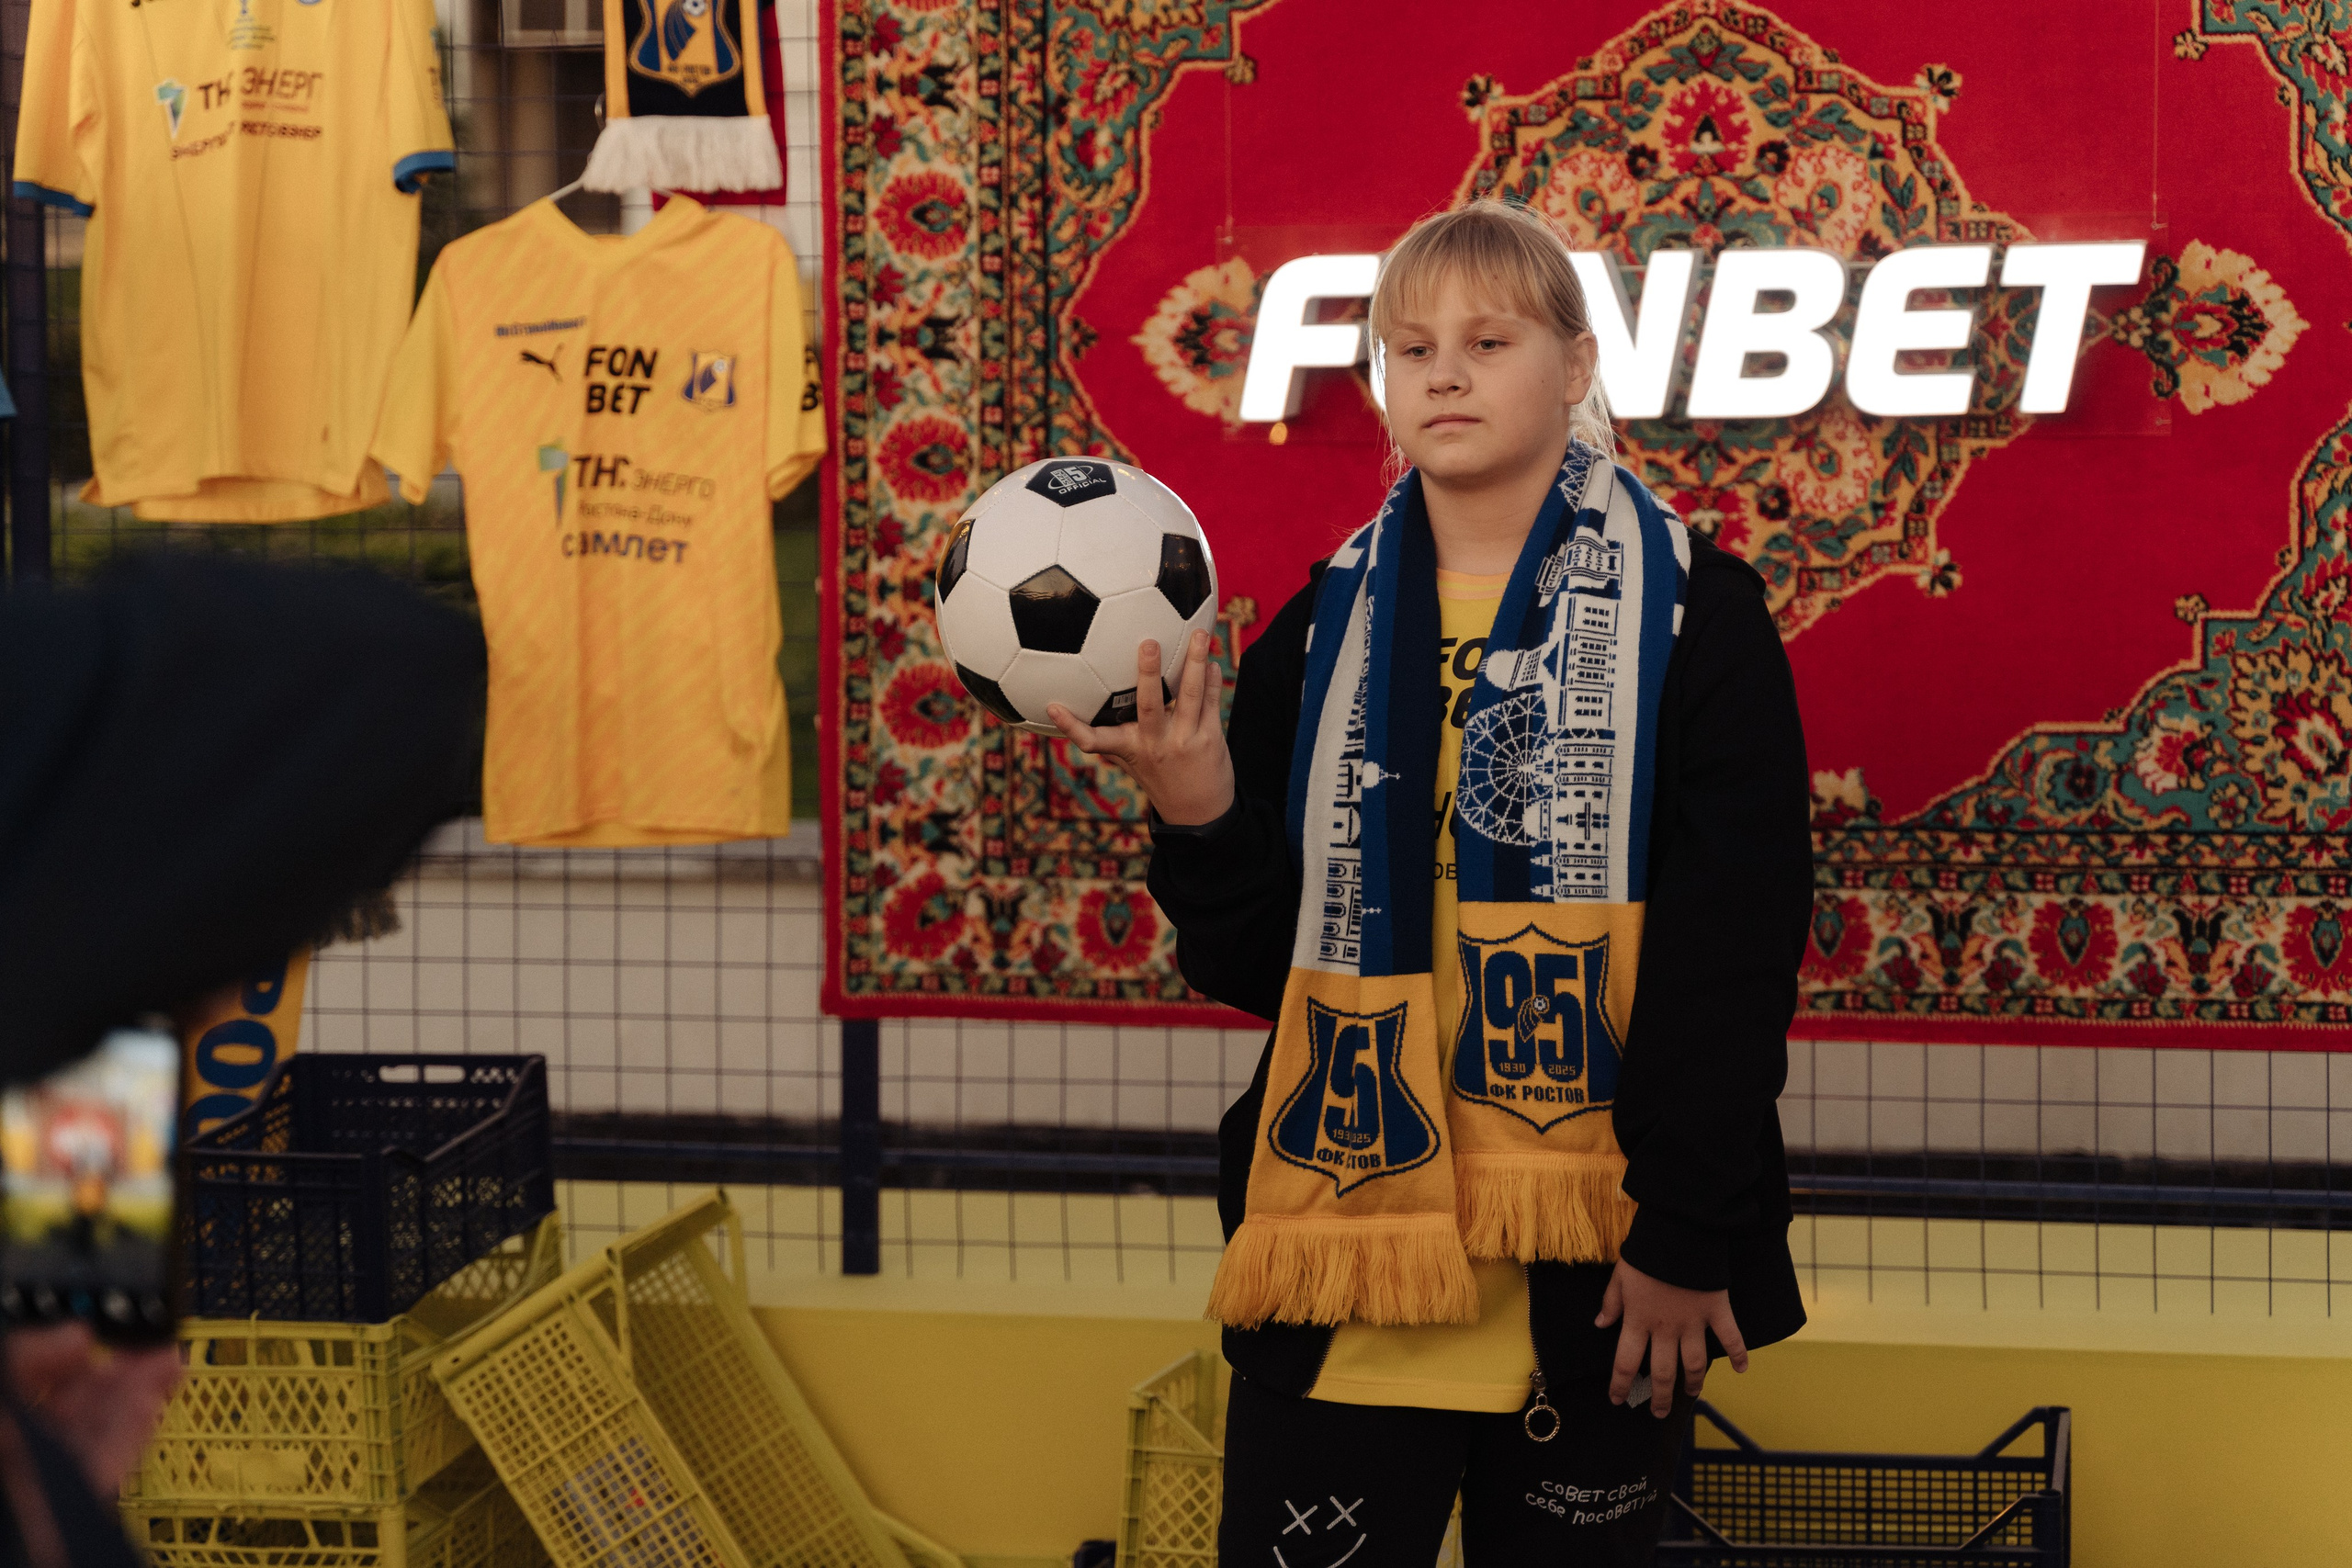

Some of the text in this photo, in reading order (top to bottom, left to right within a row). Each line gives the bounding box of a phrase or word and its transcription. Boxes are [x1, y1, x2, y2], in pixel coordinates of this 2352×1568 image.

[1238, 239, 2144, 423] FNBET
[584, 345, 658, 378] FON
[586, 383, 651, 414] BET
[1058, 478, 1107, 494] OFFICIAL
[1440, 637, 1487, 681] FO
[1484, 951, 1584, 1083] 95
[1499, 1062, 1577, 1077] 1930 2025
[1490, 1083, 1585, 1103] ФК РОСТОВ
[1317, 1147, 1346, 1167] ФК
